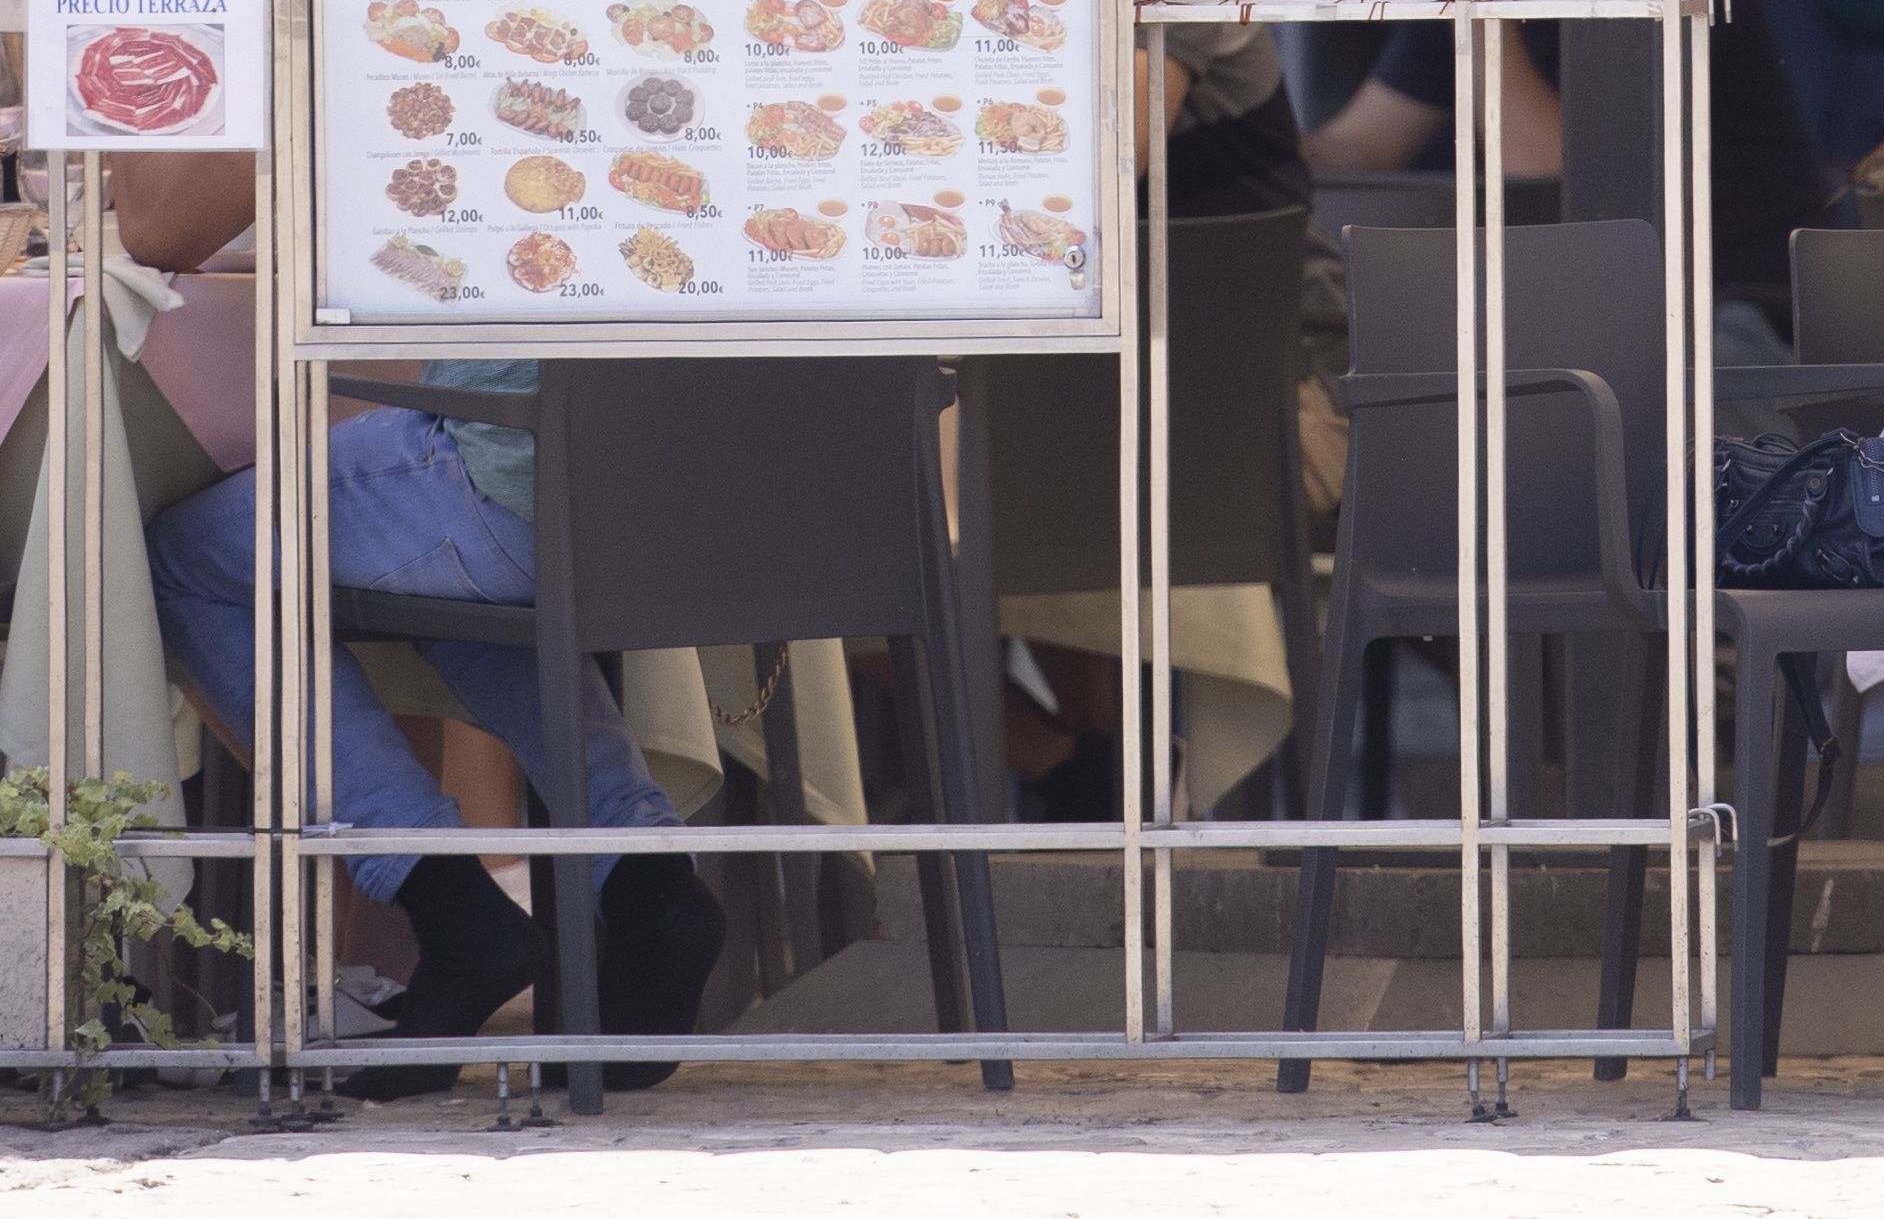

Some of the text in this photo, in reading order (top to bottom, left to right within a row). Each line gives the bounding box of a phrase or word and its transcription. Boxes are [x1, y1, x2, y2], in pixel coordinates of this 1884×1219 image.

[745, 43, 790, 58] 10,00€
[858, 41, 904, 56] 10,00€
[975, 39, 1020, 54] 11,00€
[445, 54, 481, 69] 8,00€
[564, 52, 600, 68] 8,00€
[684, 50, 720, 64] 8,00€
[753, 100, 763, 110] P4
[867, 98, 877, 108] P5
[983, 97, 994, 106] P6
[446, 132, 483, 147] 7,00€
[685, 127, 722, 143] 8,00€
[747, 145, 793, 160] 10,00€
[861, 143, 907, 158] 12,00€
[978, 141, 1023, 156] 11,50€
[754, 203, 764, 212] P7
[868, 201, 878, 210] P8
[985, 198, 996, 208] P9
[440, 209, 483, 224] 12,00€
[559, 207, 603, 221] 11,00€
[686, 205, 723, 219] 8,50€
[749, 249, 793, 263] 11,00€
[863, 247, 907, 261] 10,00€
[979, 244, 1024, 259] 11,50€
[560, 283, 605, 298] 23,00€
[678, 281, 724, 295] 20,00€
